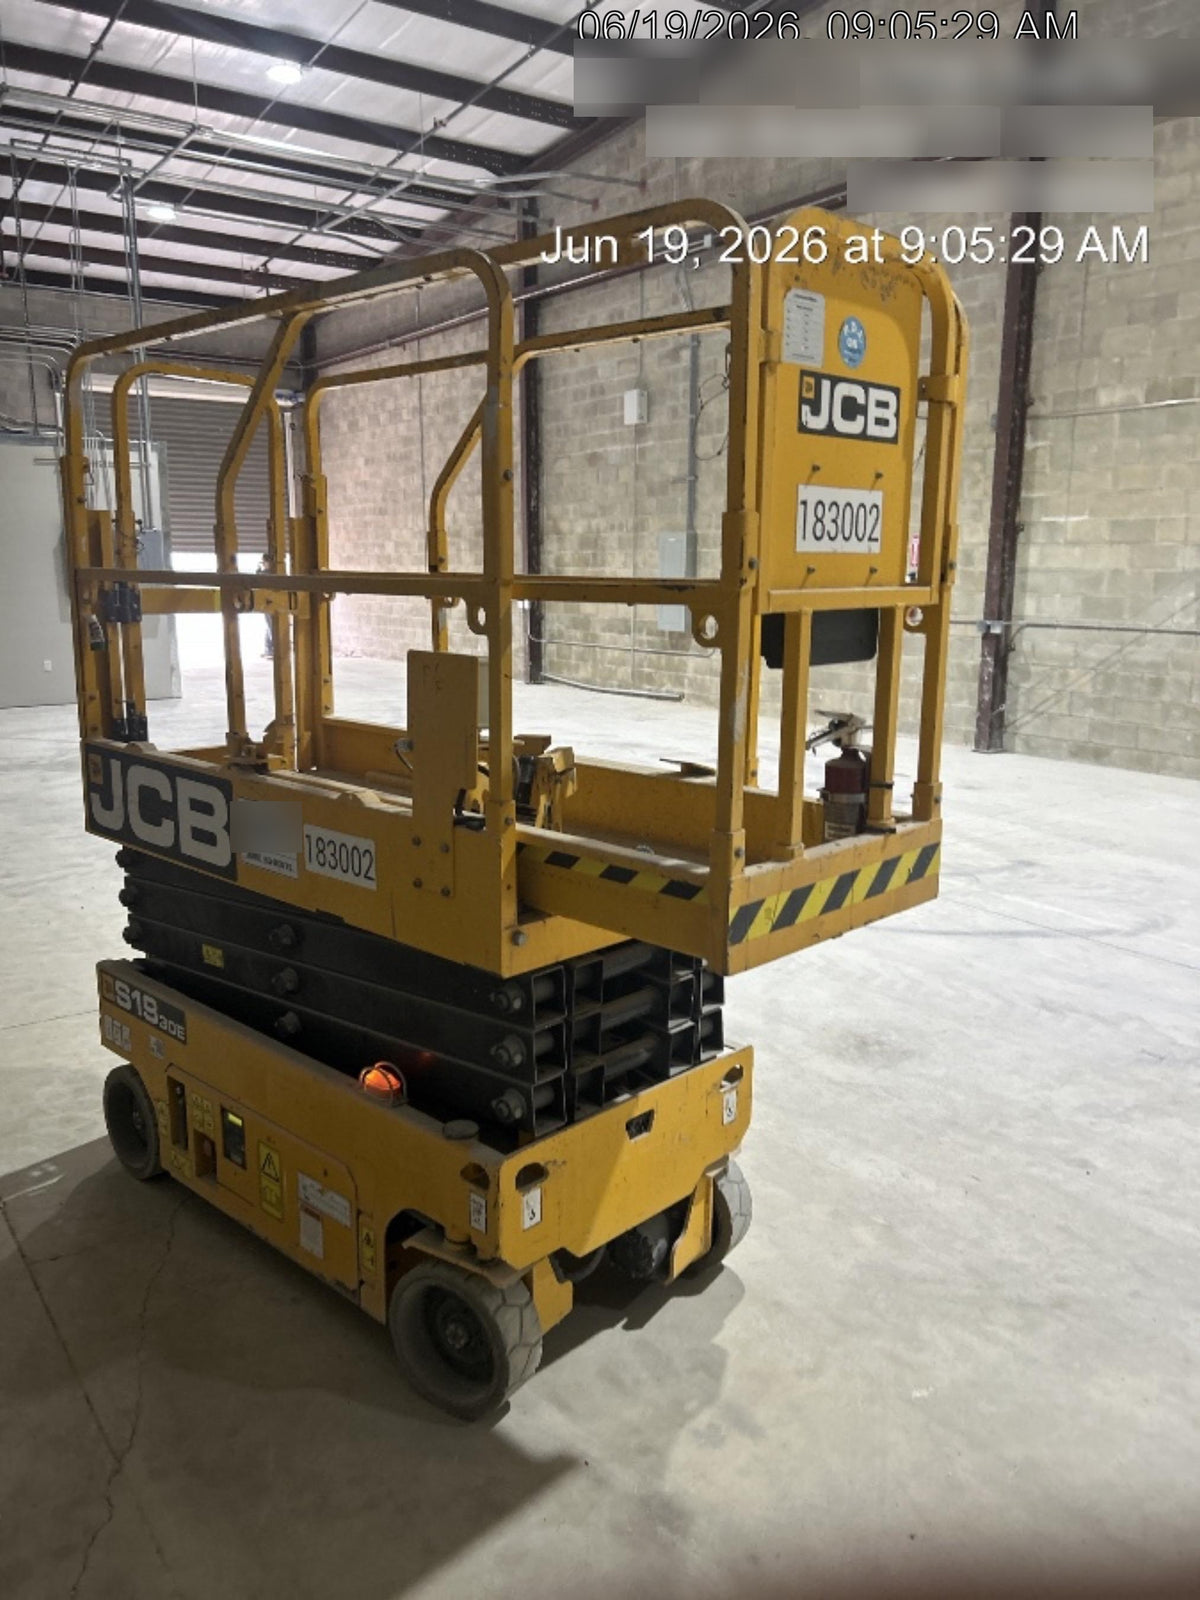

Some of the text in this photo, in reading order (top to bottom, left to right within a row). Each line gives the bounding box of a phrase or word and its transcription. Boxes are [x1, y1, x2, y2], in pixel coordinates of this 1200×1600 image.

[801, 378, 898, 439] JCB
[800, 499, 881, 543] 183002
[90, 757, 233, 868] JCB
[305, 833, 376, 882] 183002
